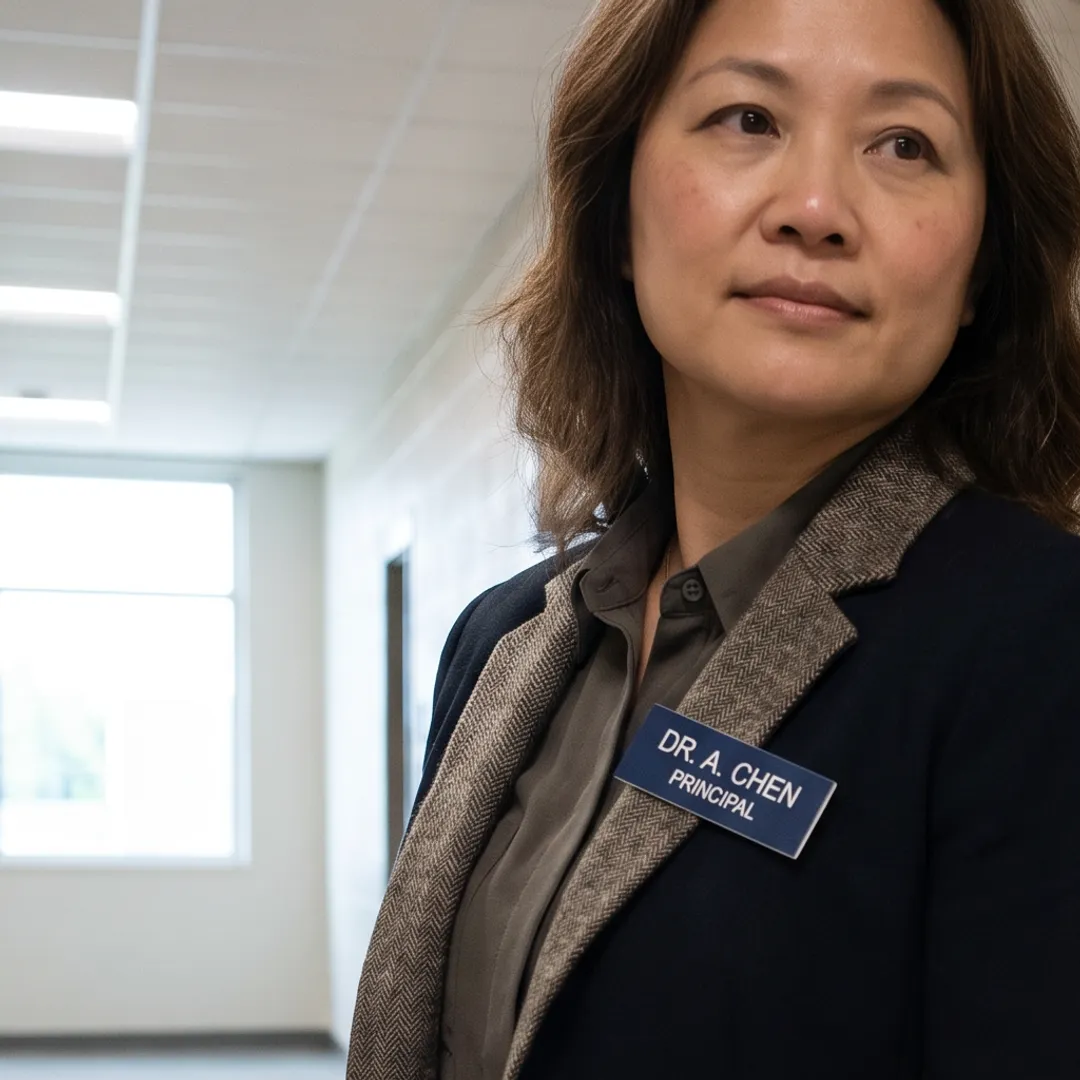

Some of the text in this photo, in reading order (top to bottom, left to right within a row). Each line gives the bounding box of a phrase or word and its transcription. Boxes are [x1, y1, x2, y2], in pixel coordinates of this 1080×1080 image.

[657, 728, 802, 808] DR. A. CHEN
[668, 769, 754, 821] PRINCIPAL
